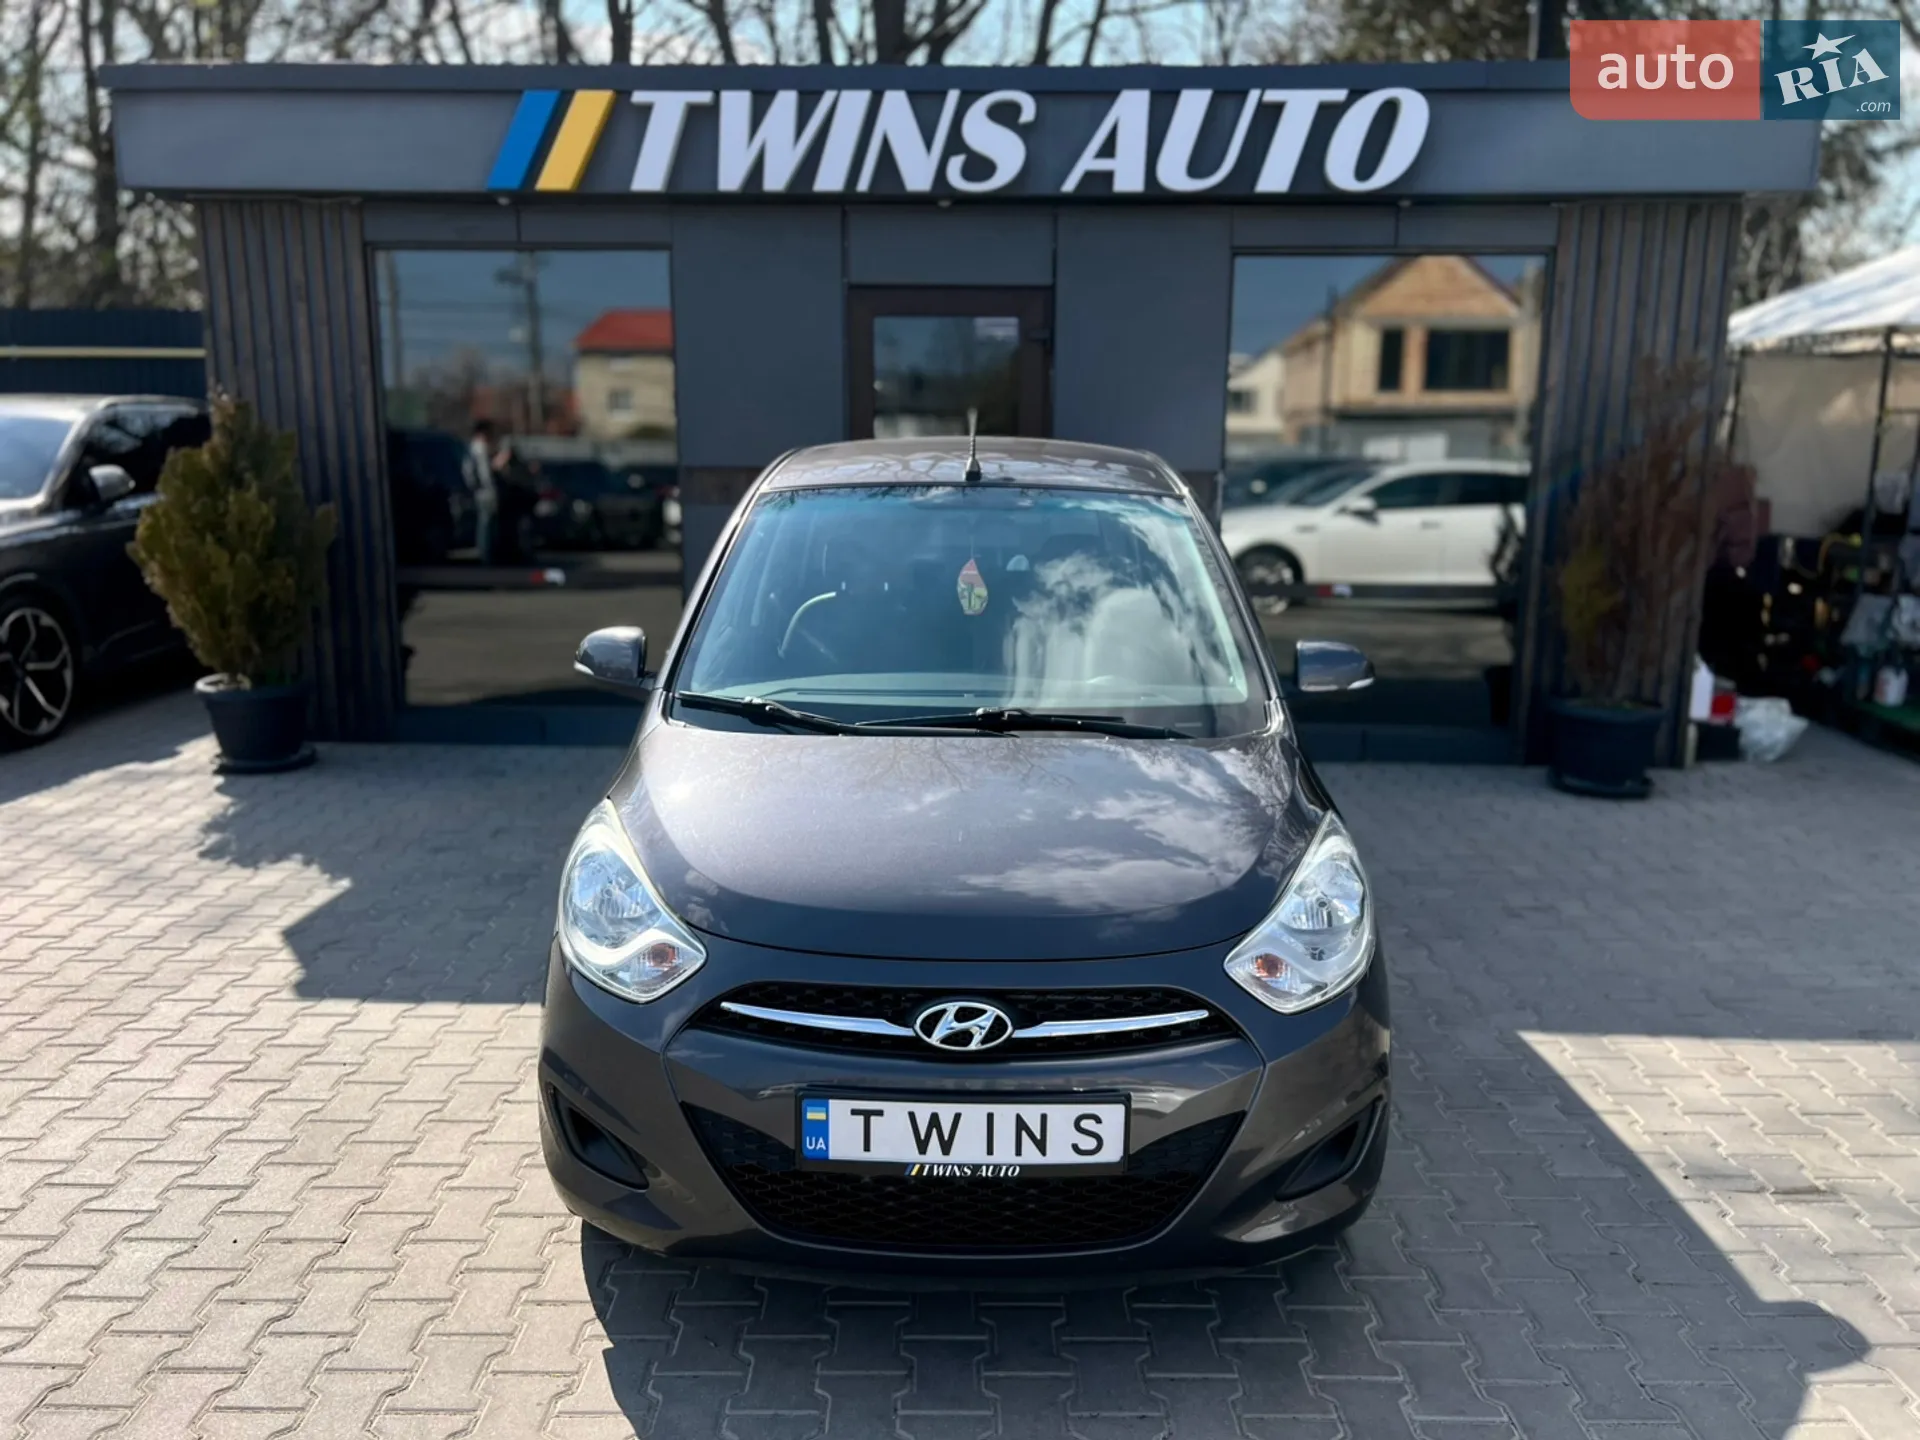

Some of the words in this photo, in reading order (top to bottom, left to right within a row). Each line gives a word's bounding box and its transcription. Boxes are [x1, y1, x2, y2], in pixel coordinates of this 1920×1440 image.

[629, 89, 1037, 194] TWINS
[1061, 87, 1431, 193] AUTO
[806, 1136, 827, 1150] UA
[850, 1109, 1103, 1156] TWINS
[921, 1164, 973, 1178] TWINS
[976, 1164, 1020, 1178] AUTO
